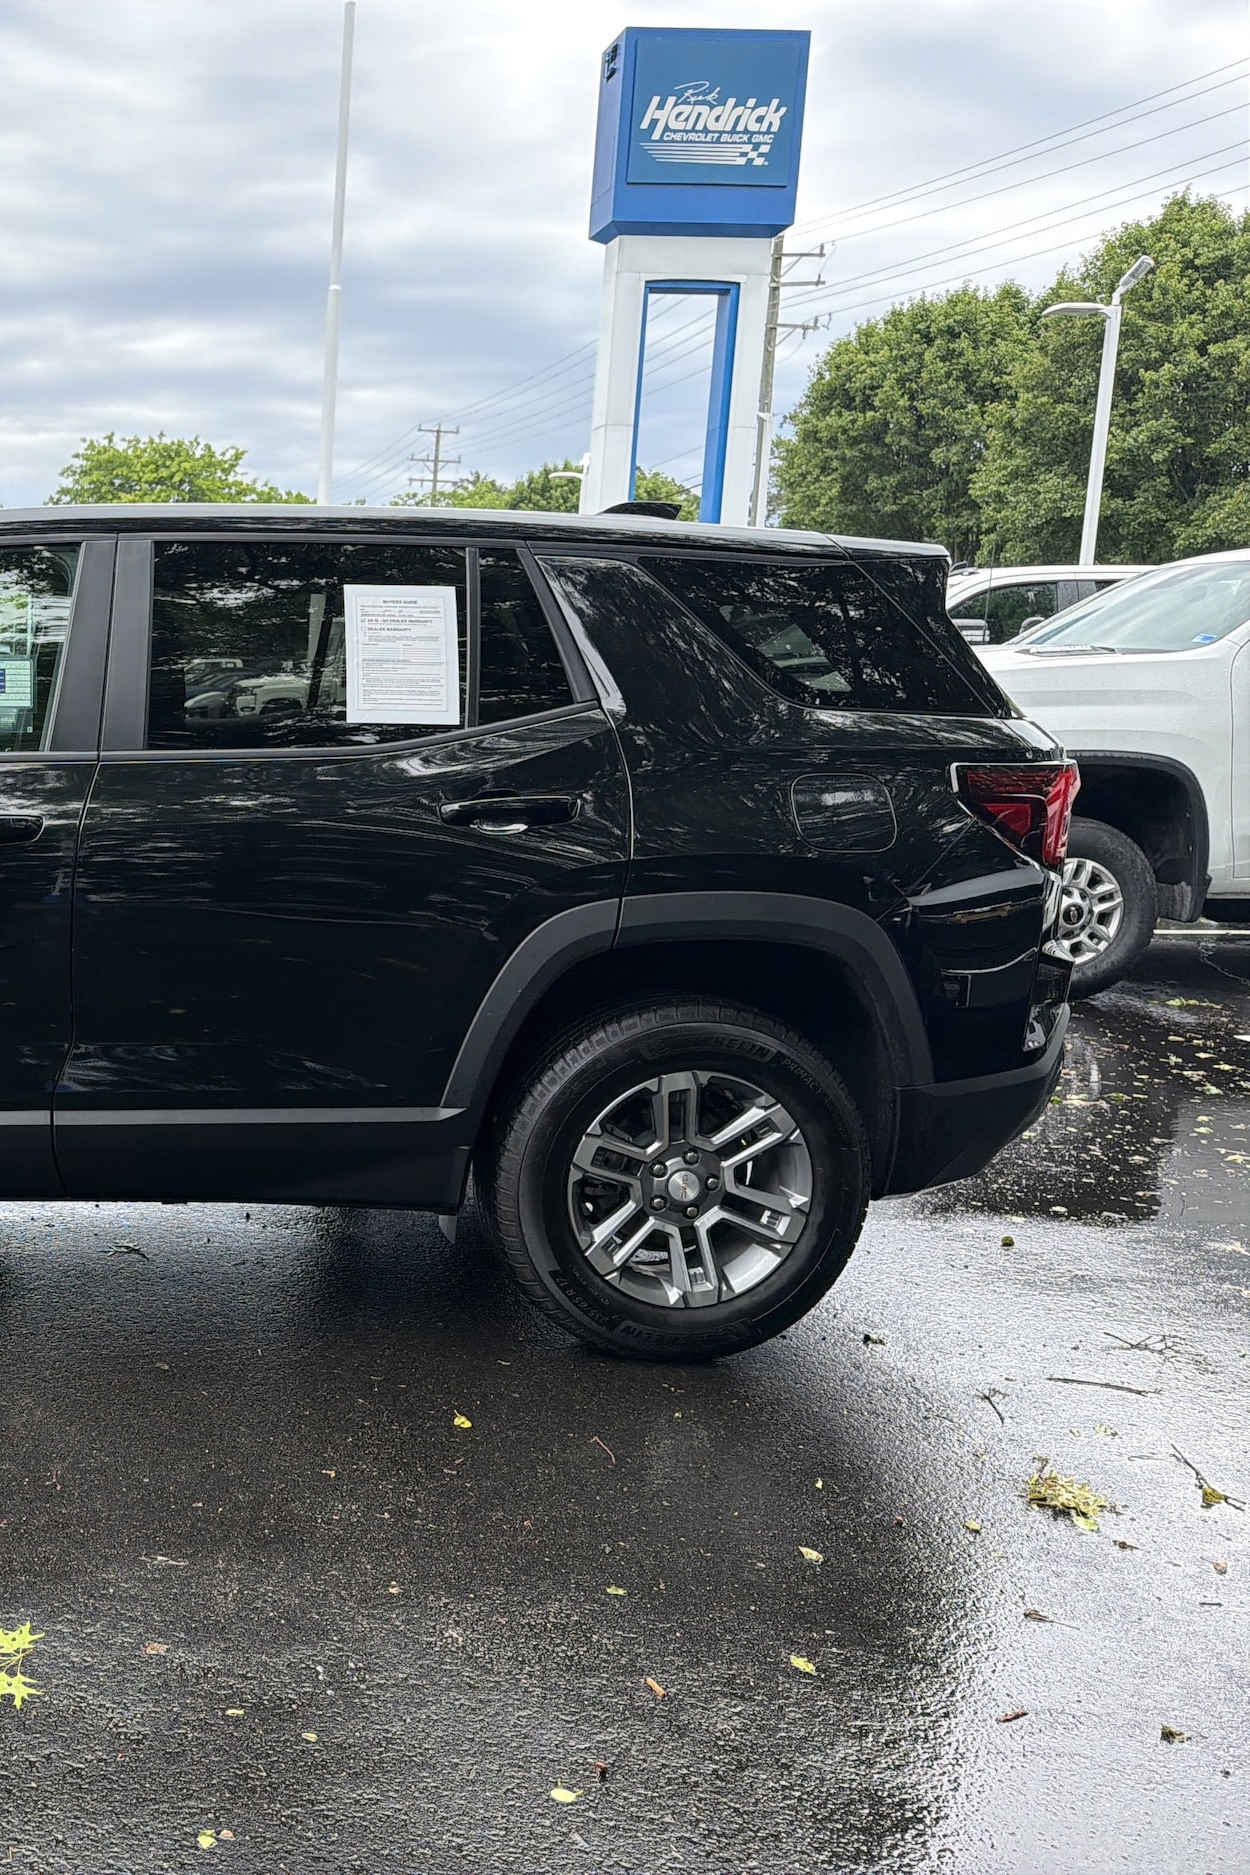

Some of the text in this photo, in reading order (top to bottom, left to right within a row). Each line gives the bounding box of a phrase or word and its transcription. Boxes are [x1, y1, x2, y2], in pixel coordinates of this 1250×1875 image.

[639, 95, 788, 140] Hendrick
[663, 132, 775, 143] CHEVROLET BUICK GMC
[780, 1057, 823, 1096] PRIMACY
